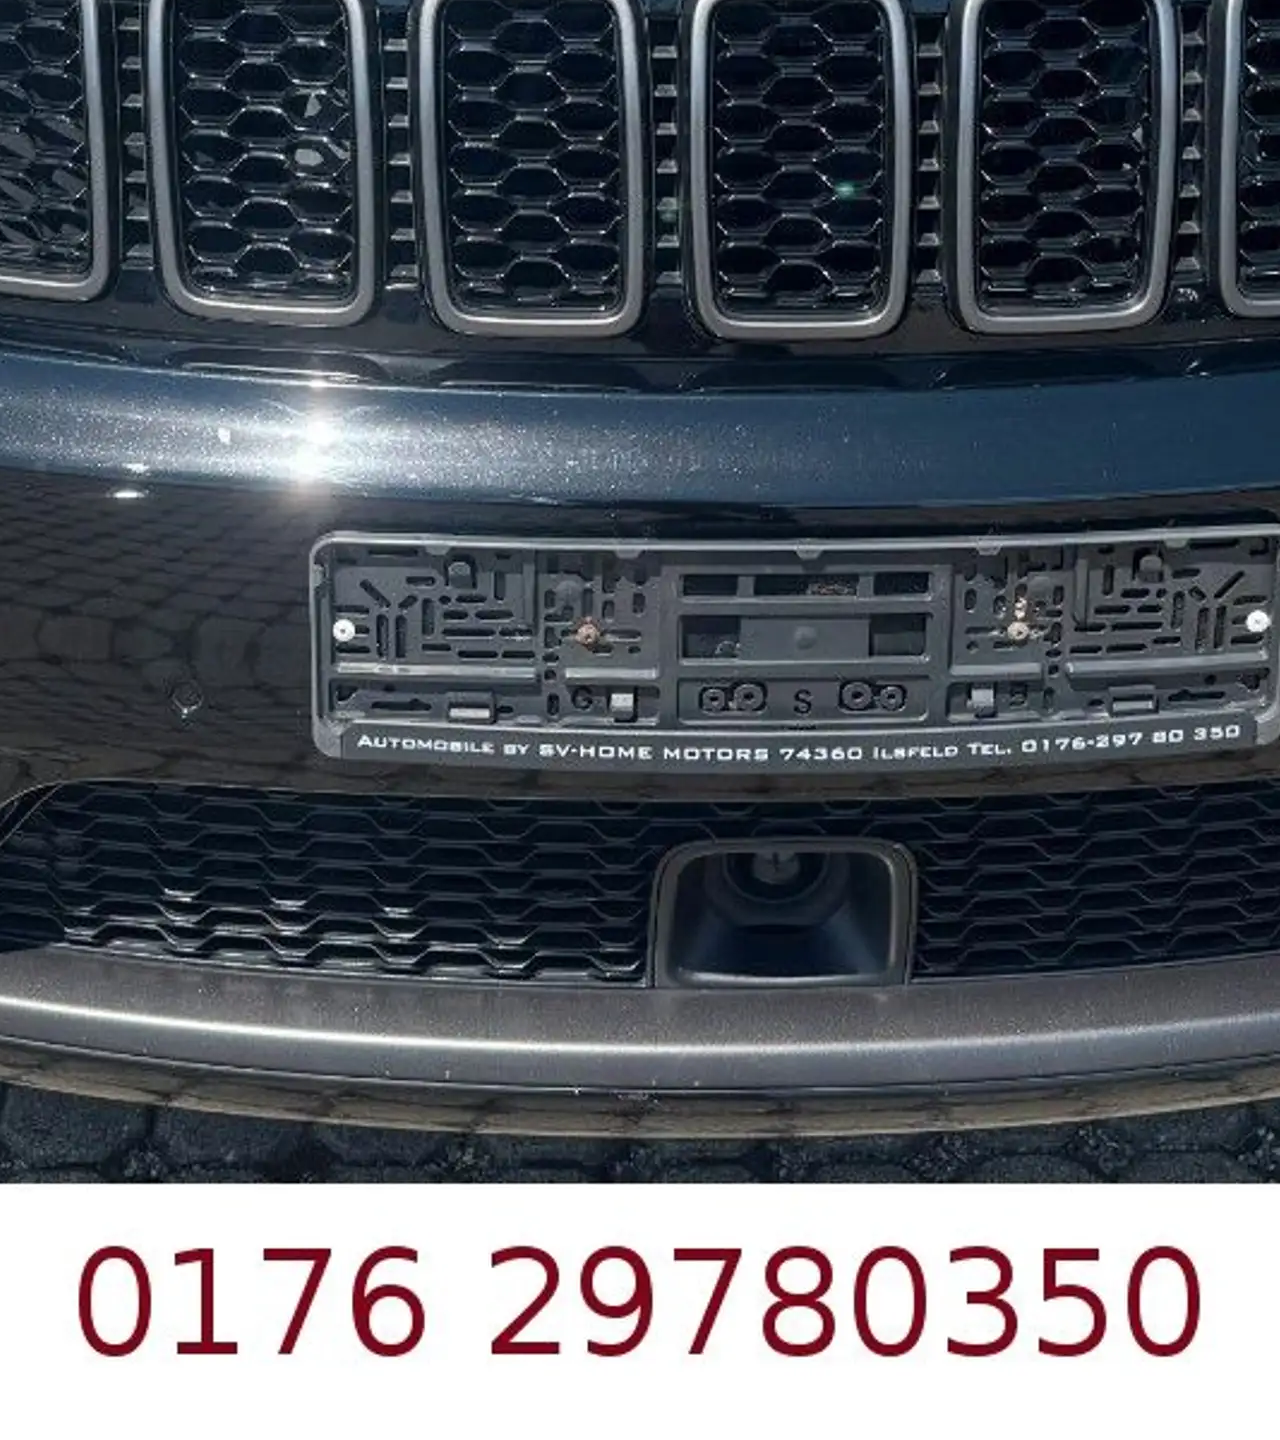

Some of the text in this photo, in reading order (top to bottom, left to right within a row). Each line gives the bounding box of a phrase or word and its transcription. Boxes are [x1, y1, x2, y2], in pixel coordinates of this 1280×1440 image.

[538, 743, 654, 761] SV-HOME
[663, 746, 769, 762] MOTORS
[778, 745, 863, 762] 74360
[1021, 730, 1145, 754] 0176-297
[1152, 727, 1184, 746] 80
[1192, 723, 1243, 742] 350
